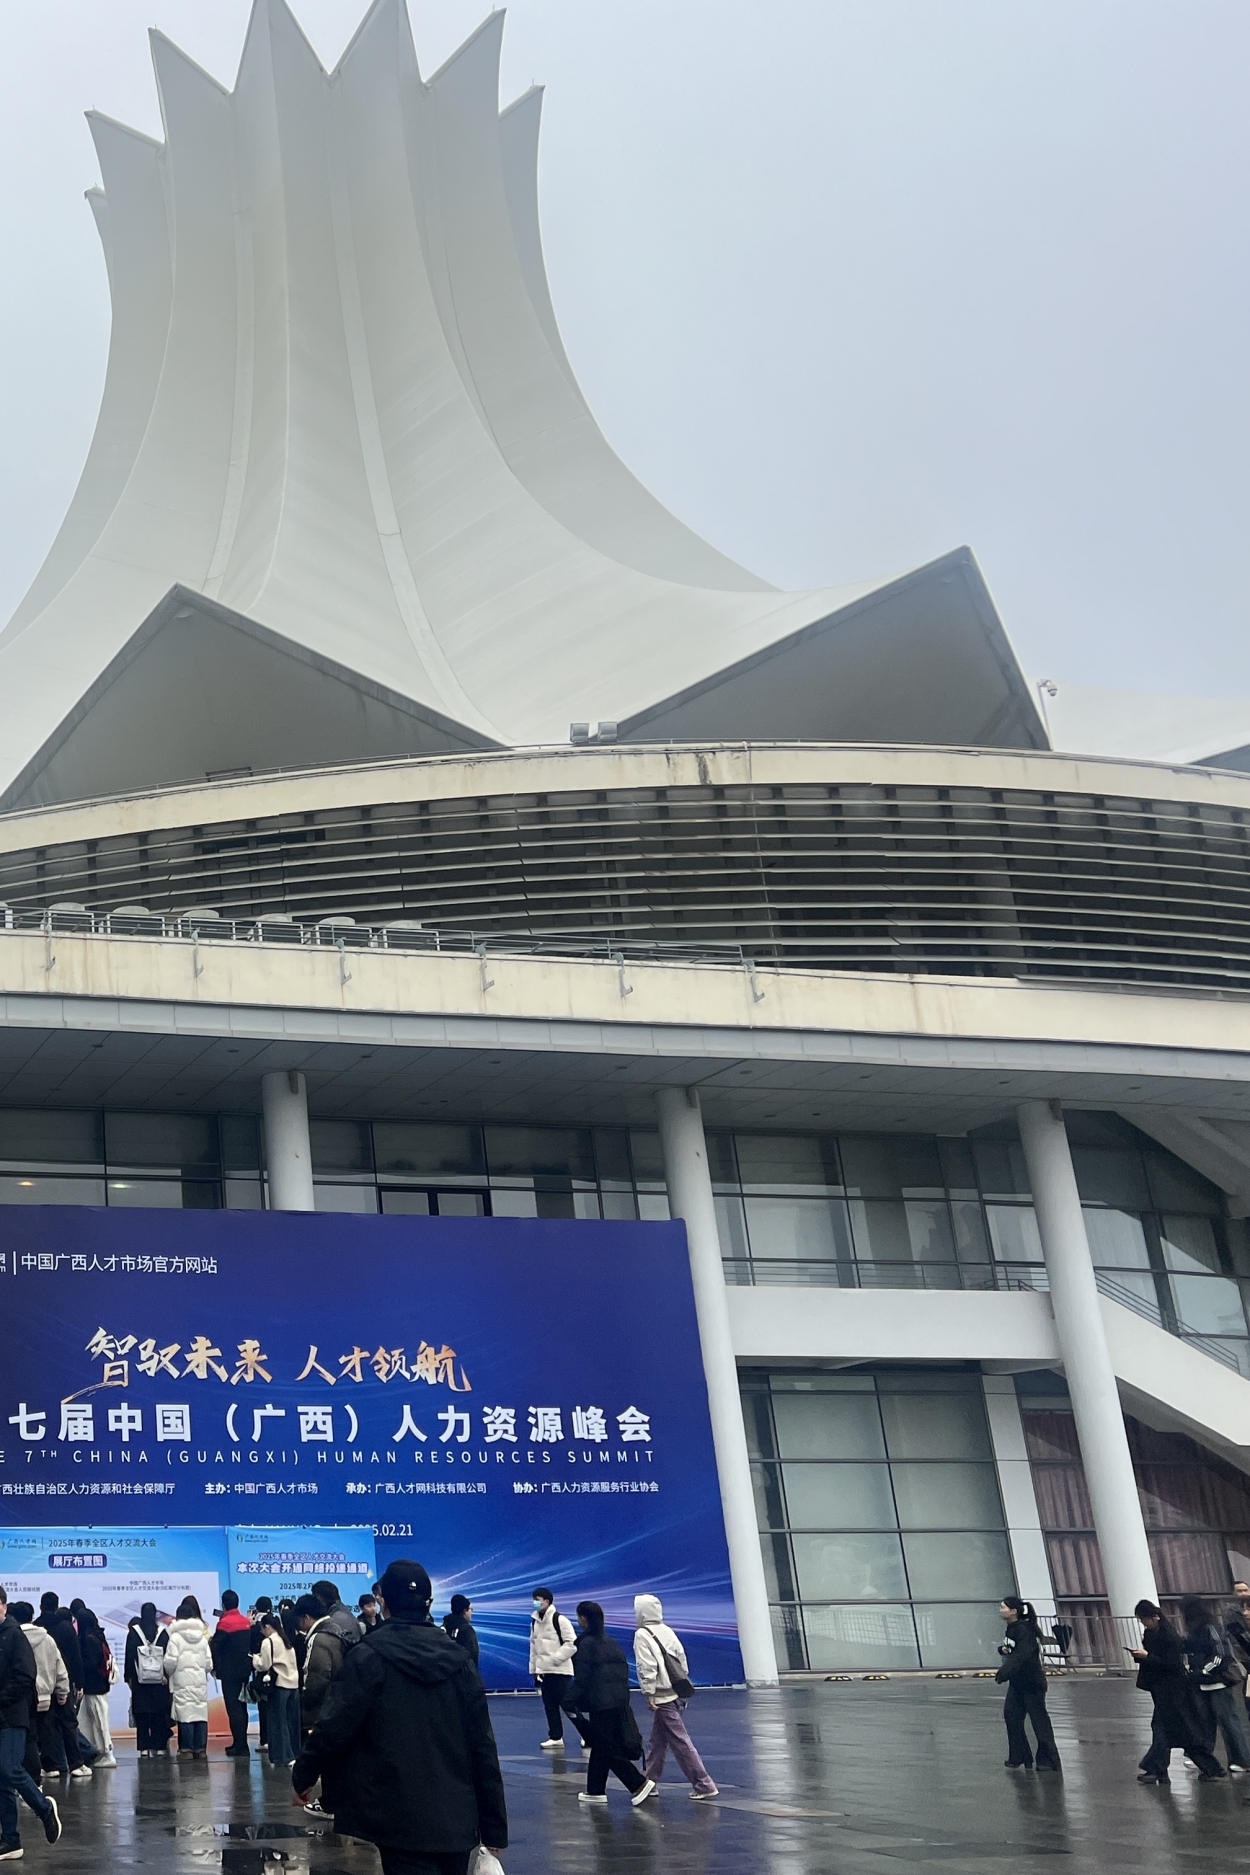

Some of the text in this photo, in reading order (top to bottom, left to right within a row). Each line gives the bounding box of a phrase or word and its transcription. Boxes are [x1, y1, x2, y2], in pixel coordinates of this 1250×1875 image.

[21, 1253, 217, 1274] 中国广西人才市场官方网站
[70, 1326, 472, 1395] 智驭未来 人才领航
[73, 1451, 148, 1463] CHINA
[167, 1450, 299, 1466] (GUANGXI)
[318, 1451, 396, 1463] HUMAN
[415, 1451, 551, 1463] RESOURCES
[568, 1451, 654, 1463] SUMMIT
[351, 1524, 413, 1537] 5.02.21
[48, 1538, 157, 1548] 2025年春季全区人才交流大会
[53, 1555, 103, 1567] 展厅布置图
